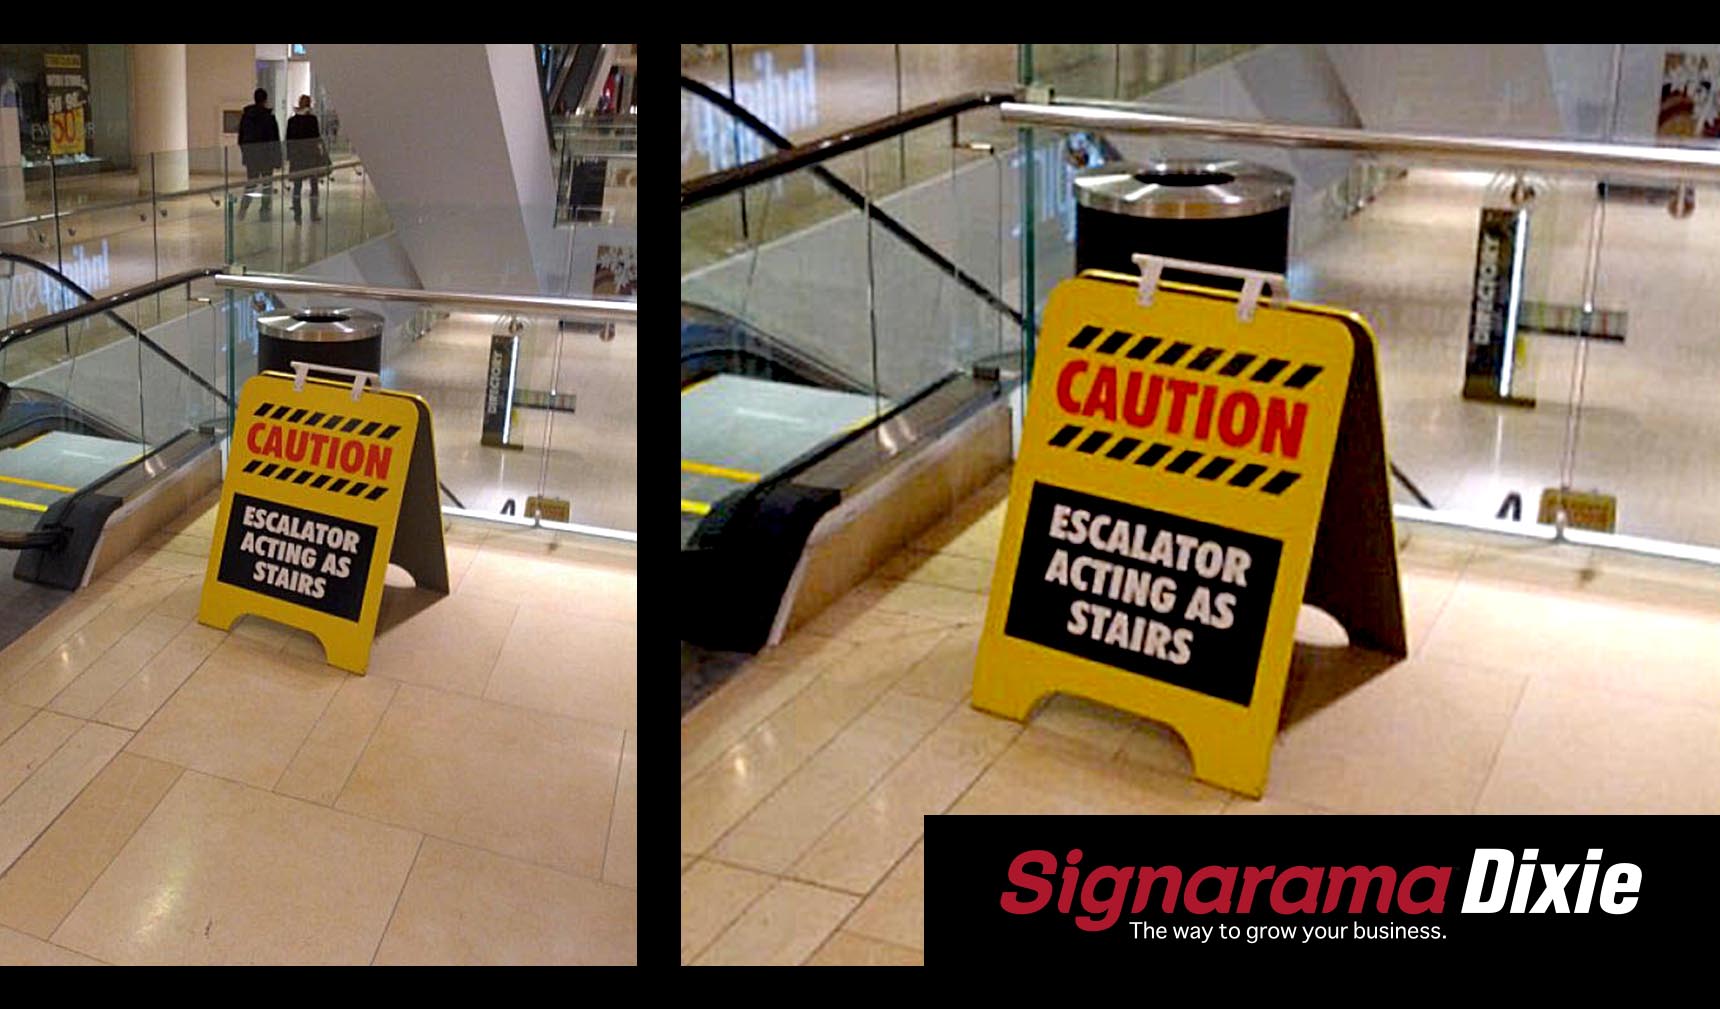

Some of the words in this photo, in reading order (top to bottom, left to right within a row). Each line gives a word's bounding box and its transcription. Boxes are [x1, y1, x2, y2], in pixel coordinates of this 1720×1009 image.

[1056, 359, 1309, 460] CAUTION
[246, 422, 393, 480] CAUTION
[240, 531, 318, 569] ACTING
[320, 552, 352, 578] AS
[243, 505, 361, 555] ESCALATOR
[1049, 504, 1252, 587] ESCALATOR
[253, 560, 328, 599] STAIRS
[1044, 549, 1178, 614] ACTING
[1184, 586, 1238, 630] AS
[1066, 600, 1195, 666] STAIRS
